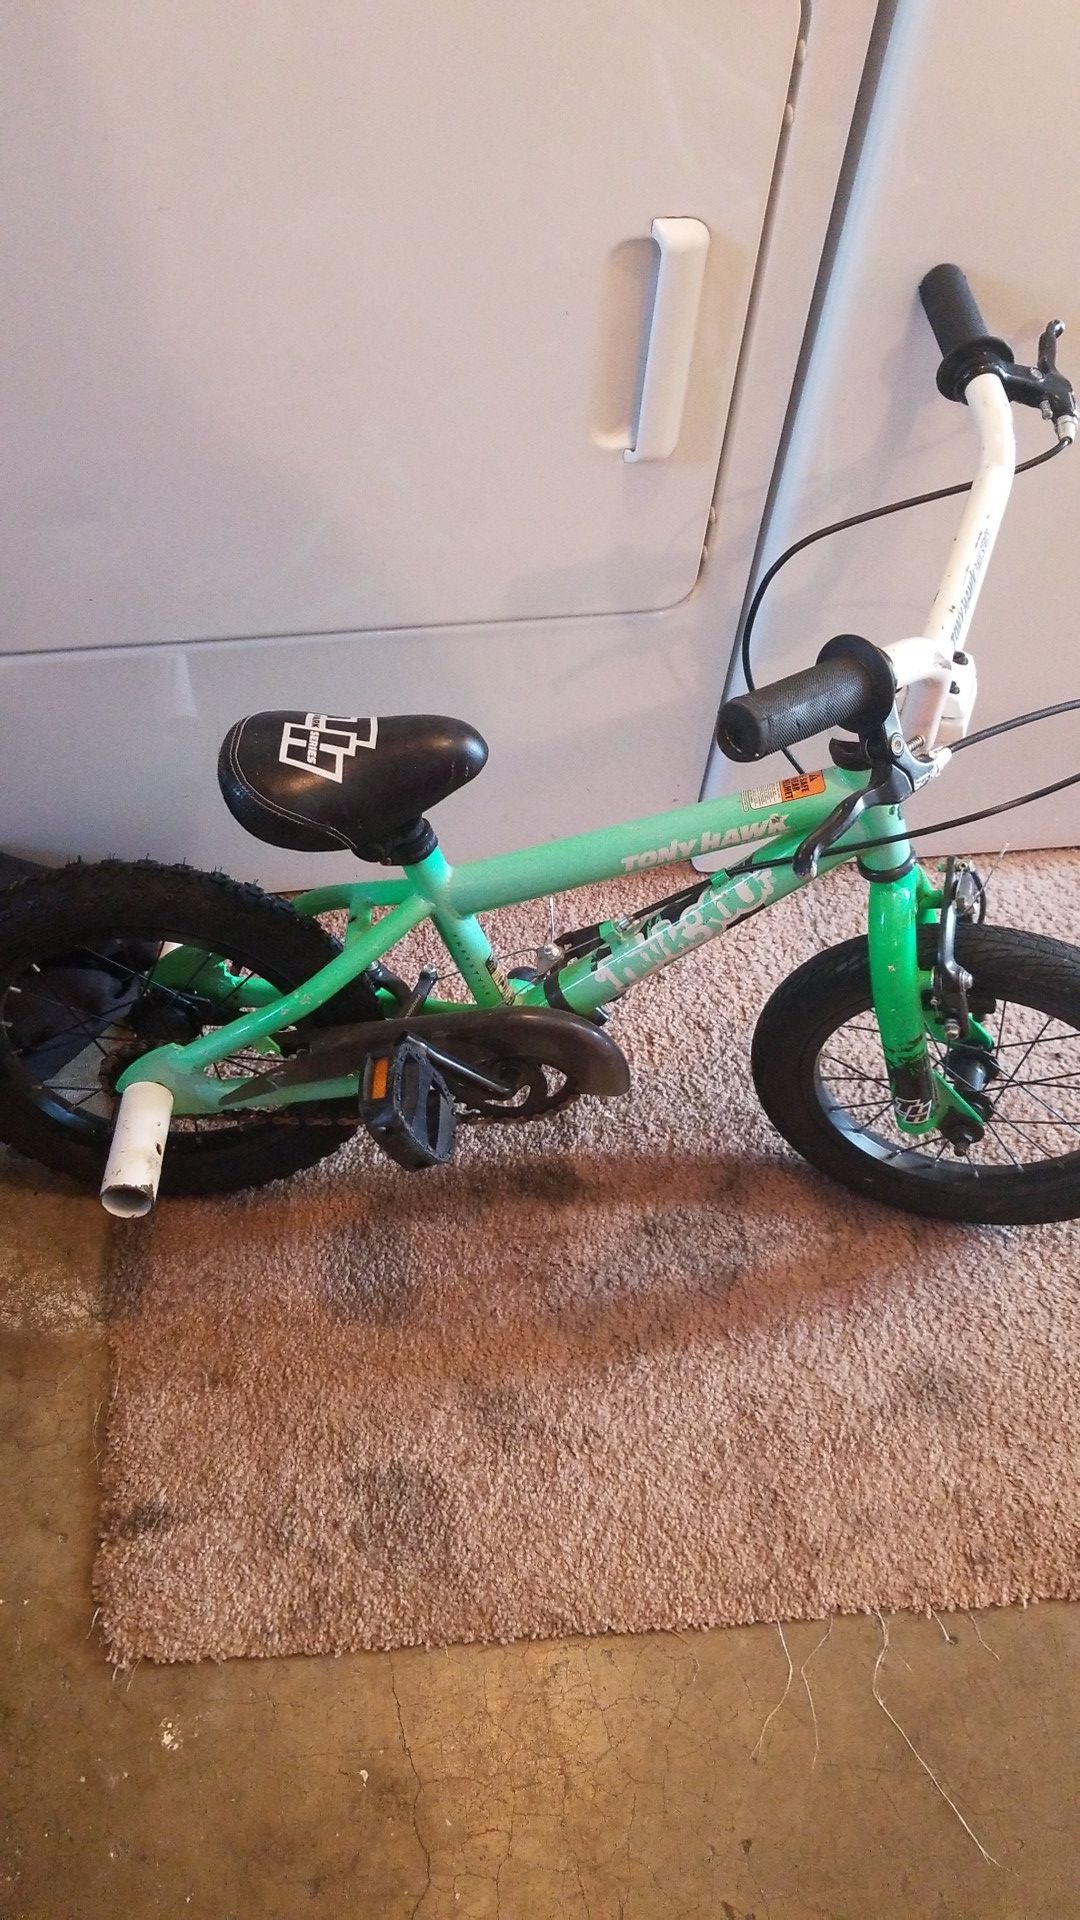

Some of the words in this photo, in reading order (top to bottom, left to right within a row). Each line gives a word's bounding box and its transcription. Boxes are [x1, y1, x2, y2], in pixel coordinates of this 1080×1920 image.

[306, 730, 321, 765] SERIES
[620, 838, 698, 872] TONY
[701, 813, 790, 852] HAWK
